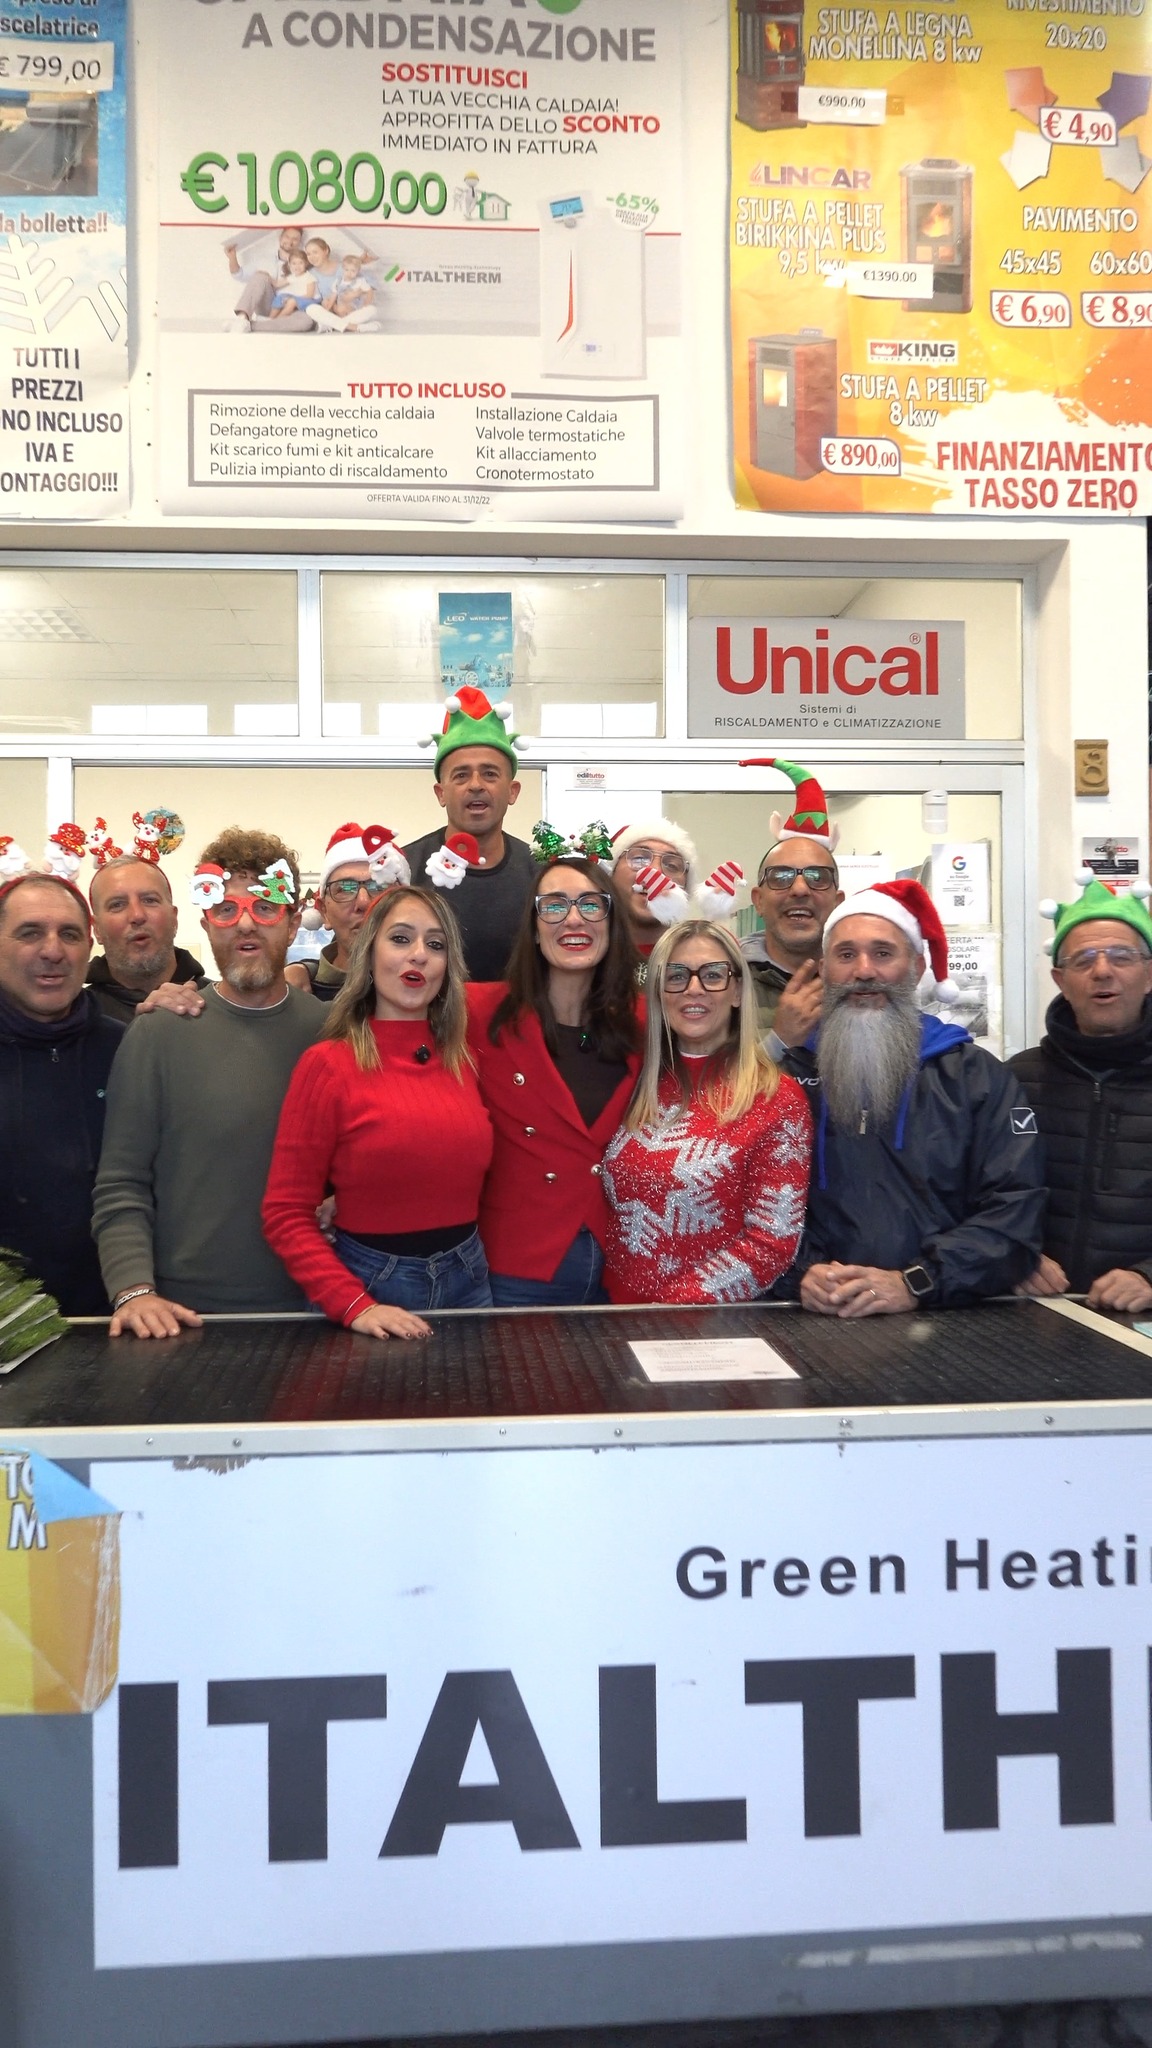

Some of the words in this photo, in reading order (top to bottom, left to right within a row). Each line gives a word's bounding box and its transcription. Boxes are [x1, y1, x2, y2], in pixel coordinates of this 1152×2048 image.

[818, 8, 879, 36] STUFA
[885, 11, 904, 35] A
[907, 13, 973, 39] LEGNA
[242, 12, 272, 48] A
[282, 10, 656, 62] CONDENSAZIONE
[1046, 21, 1107, 51] 20x20
[809, 35, 928, 62] MONELLINA
[932, 41, 946, 63] 8
[952, 38, 982, 64] kw
[17, 55, 101, 85] 799,00
[382, 62, 528, 89] SOSTITUISCI
[382, 90, 404, 106] LA
[409, 89, 446, 106] TUA
[450, 91, 531, 112] VECCHIA
[536, 98, 619, 113] CALDAIA!
[818, 96, 866, 110] €990.00
[382, 112, 494, 131] APPROFITTA
[500, 116, 557, 134] DELLO
[562, 115, 660, 134] SCONTO
[1044, 111, 1062, 139] €
[1069, 112, 1113, 145] 4,90
[382, 134, 488, 153] IMMEDIATO
[494, 138, 511, 153] IN
[517, 139, 598, 154] FATTURA
[763, 165, 872, 190] LINCAR
[606, 193, 659, 214] -65%
[736, 197, 796, 224] STUFA
[803, 199, 819, 225] A
[824, 200, 885, 229] PELLET
[20, 212, 108, 233] bolletta!!
[1022, 206, 1139, 233] PAVIMENTO
[735, 222, 836, 250] BIRIKKINA
[841, 227, 887, 254] PLUS
[778, 251, 809, 278] 9,5
[999, 248, 1062, 276] 45x45
[1089, 250, 1152, 277] 60x60
[407, 271, 502, 284] ITALTHERM
[863, 269, 917, 284] €1390.00
[995, 294, 1014, 323] €
[1020, 295, 1066, 326] 6,90
[1086, 295, 1105, 324] €
[13, 347, 69, 368] TUTTI
[74, 348, 79, 369] I
[898, 342, 956, 358] KING
[12, 377, 83, 402] PREZZI
[348, 383, 413, 399] TUTTO
[418, 383, 506, 399] INCLUSO
[840, 373, 901, 401] STUFA
[904, 376, 921, 401] A
[926, 377, 987, 403] PELLET
[36, 411, 123, 433] INCLUSO
[210, 404, 287, 418] Rimozione
[290, 405, 325, 419] della
[329, 406, 381, 420] vecchia
[385, 406, 435, 420] caldaia
[476, 406, 563, 422] Installazione
[566, 409, 618, 423] Caldaia
[889, 401, 903, 427] 8
[908, 400, 939, 427] kw
[210, 423, 298, 439] Defangatore
[302, 427, 378, 440] magnetico
[476, 426, 525, 441] Valvole
[528, 428, 626, 442] termostatiche
[25, 442, 57, 462] IVA
[63, 443, 74, 462] E
[210, 442, 230, 456] Kit
[233, 442, 282, 456] scarico
[286, 442, 319, 457] fumi
[323, 447, 332, 457] e
[336, 444, 353, 457] kit
[357, 445, 434, 459] anticalcare
[476, 446, 495, 460] Kit
[499, 446, 597, 461] allacciamento
[823, 442, 836, 466] €
[841, 443, 898, 470] 890,00
[210, 462, 257, 476] Pulizia
[261, 462, 326, 479] impianto
[330, 463, 343, 477] di
[347, 463, 448, 478] riscaldamento
[476, 465, 595, 481] Cronotermostato
[367, 494, 400, 503] OFFERTA
[402, 494, 430, 503] VALIDA
[432, 495, 450, 503] FINO
[452, 495, 461, 503] AL
[964, 477, 1059, 510] TASSO
[1067, 478, 1138, 511] ZERO
[716, 626, 939, 696] Unical
[799, 703, 842, 714] Sistemi
[846, 703, 857, 714] di
[714, 717, 818, 729] RISCALDAMENTO
[822, 719, 829, 729] e
[833, 718, 942, 729] CLIMATIZZAZIONE
[676, 1545, 906, 1600] Green
[118, 1646, 1152, 1870] ITALTH
